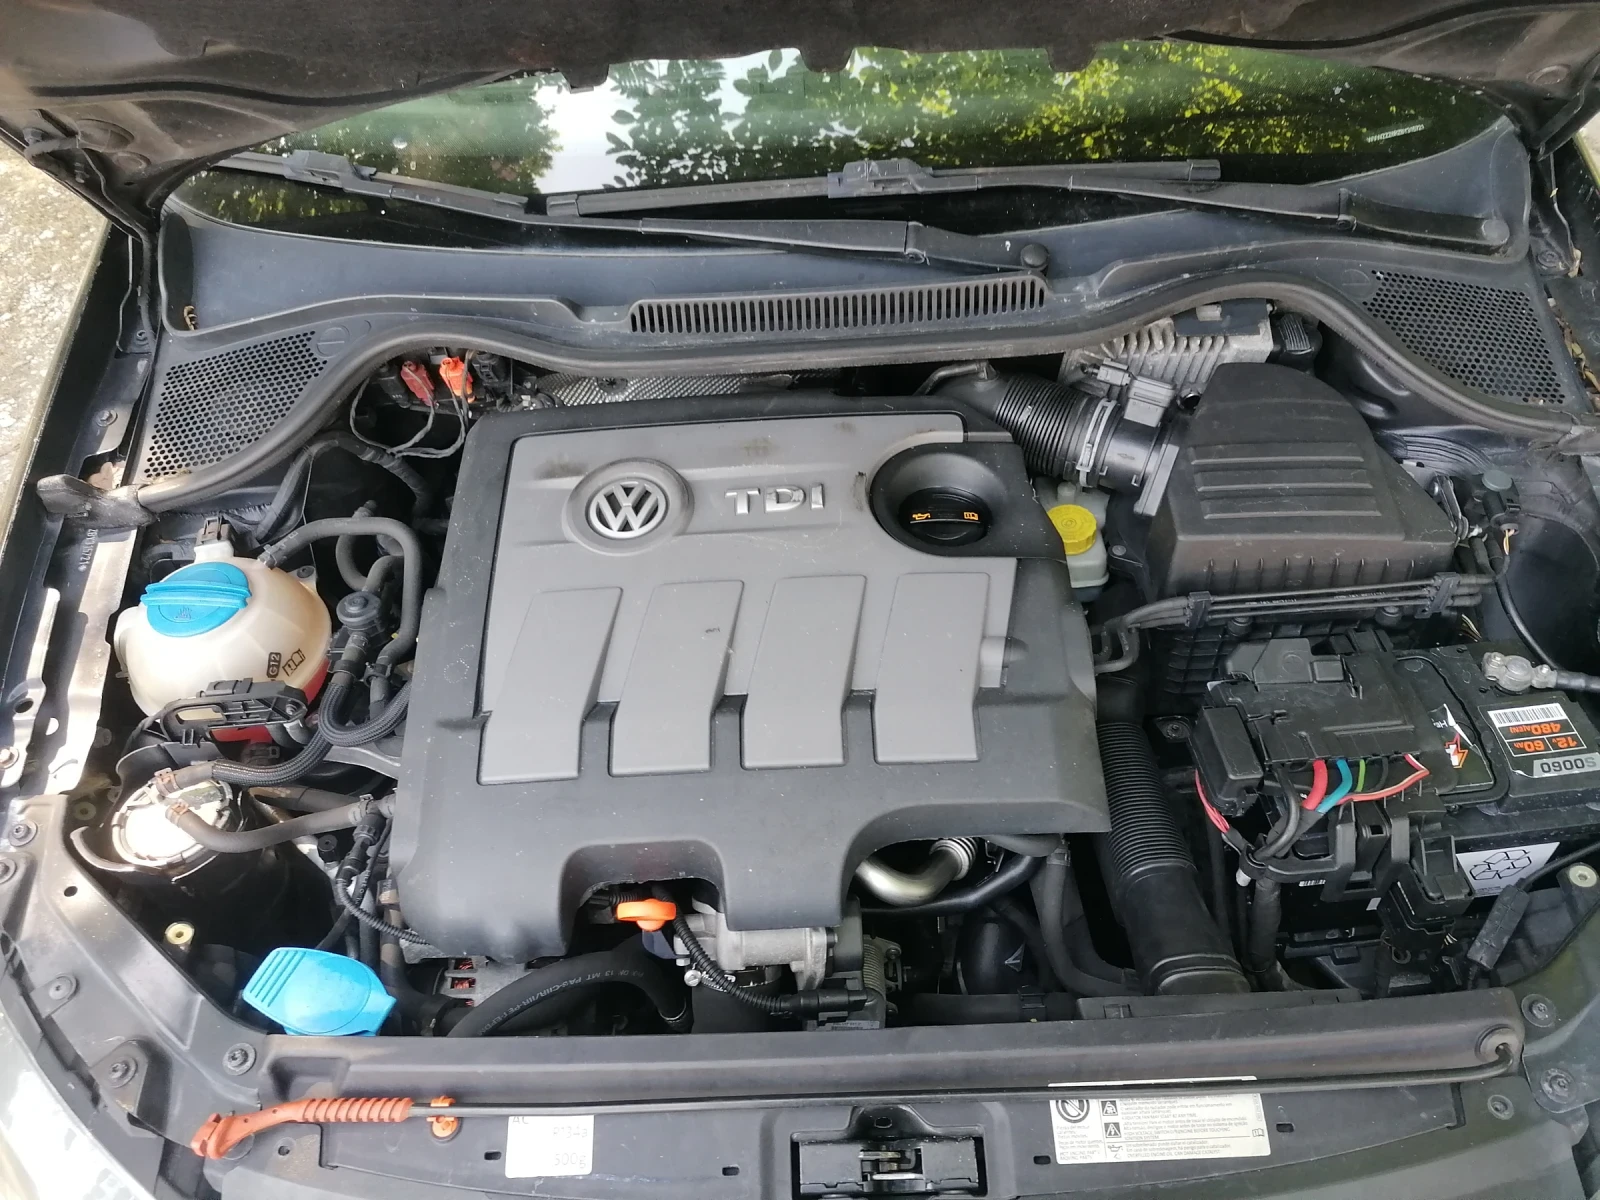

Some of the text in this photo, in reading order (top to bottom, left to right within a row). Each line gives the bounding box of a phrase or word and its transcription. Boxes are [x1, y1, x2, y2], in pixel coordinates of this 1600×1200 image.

[725, 482, 825, 515] TDI
[269, 653, 280, 675] G12
[1540, 756, 1597, 773] S0060
[554, 1152, 587, 1169] 500g
